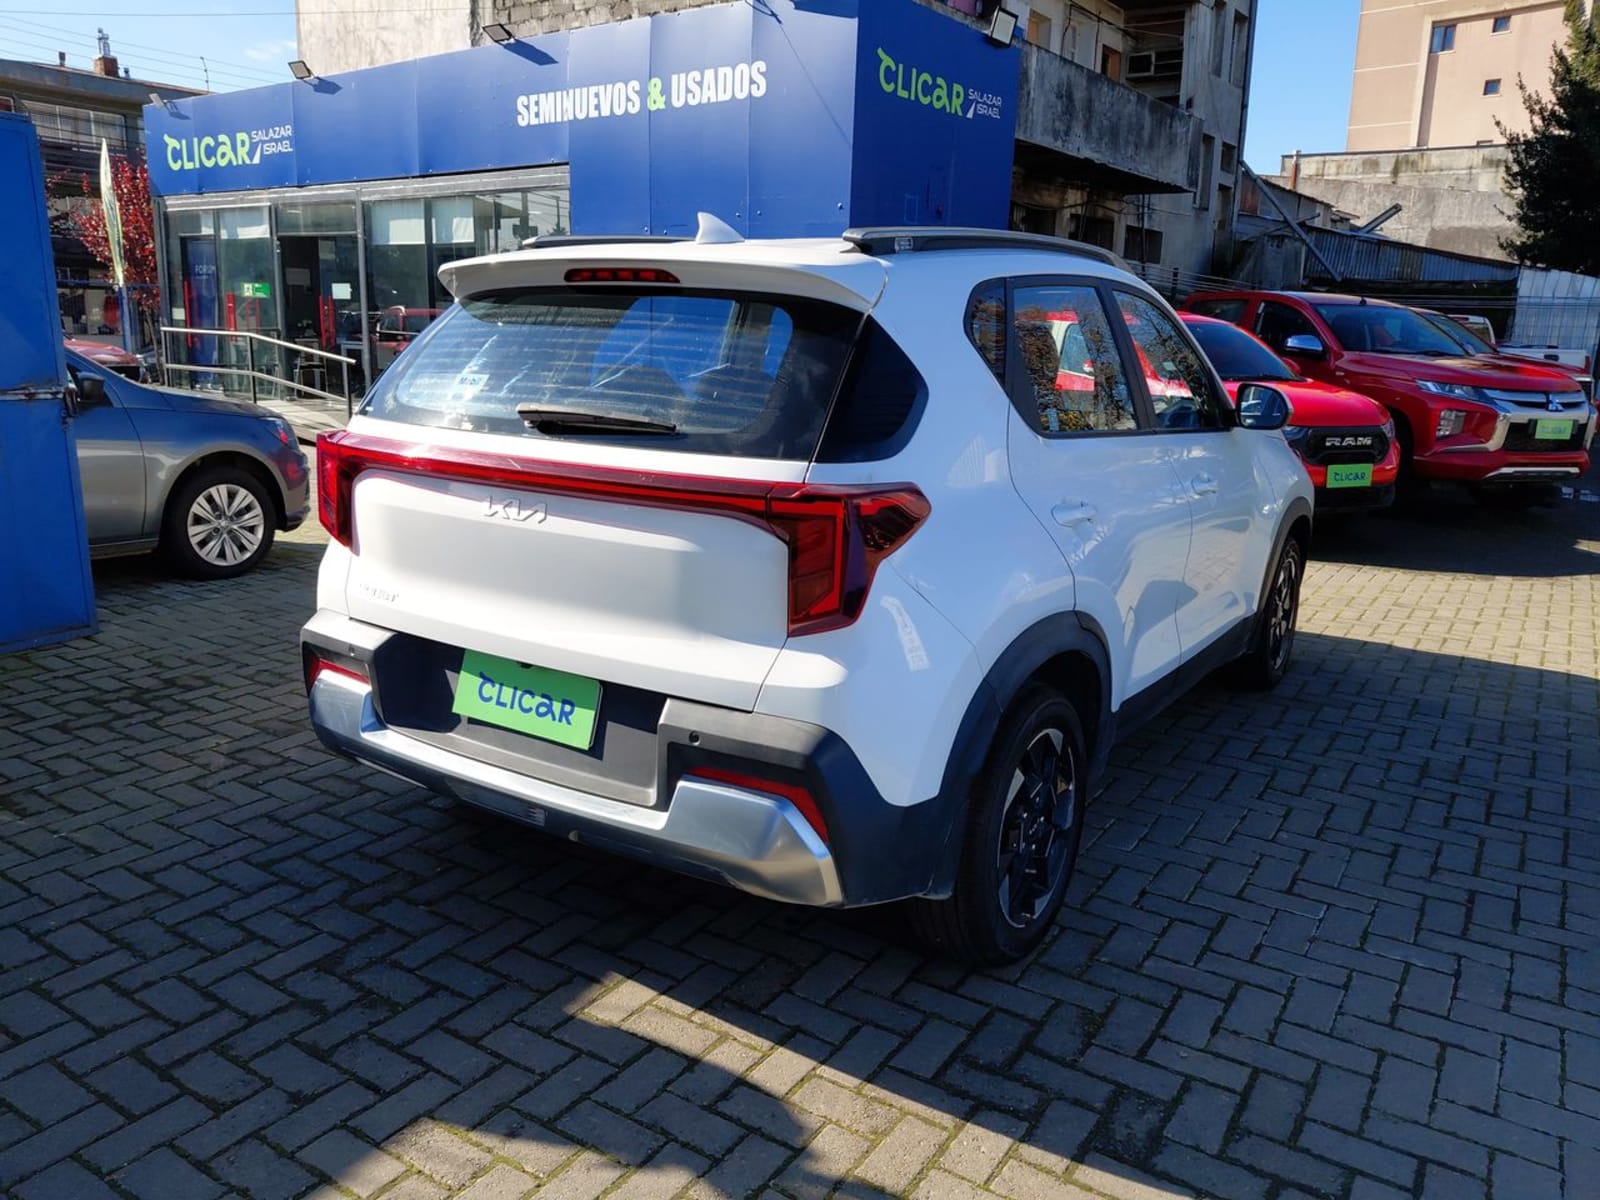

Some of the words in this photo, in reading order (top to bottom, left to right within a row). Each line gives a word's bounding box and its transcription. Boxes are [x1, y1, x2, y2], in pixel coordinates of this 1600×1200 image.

[516, 80, 641, 127] SEMINUEVOS
[647, 77, 665, 112] &
[671, 61, 767, 108] USADOS
[968, 89, 1002, 107] SALAZAR
[976, 104, 1001, 119] ISRAEL
[251, 125, 292, 142] SALAZAR
[263, 140, 293, 155] ISRAEL
[1325, 436, 1373, 447] RAM
[484, 496, 548, 524] KIA
